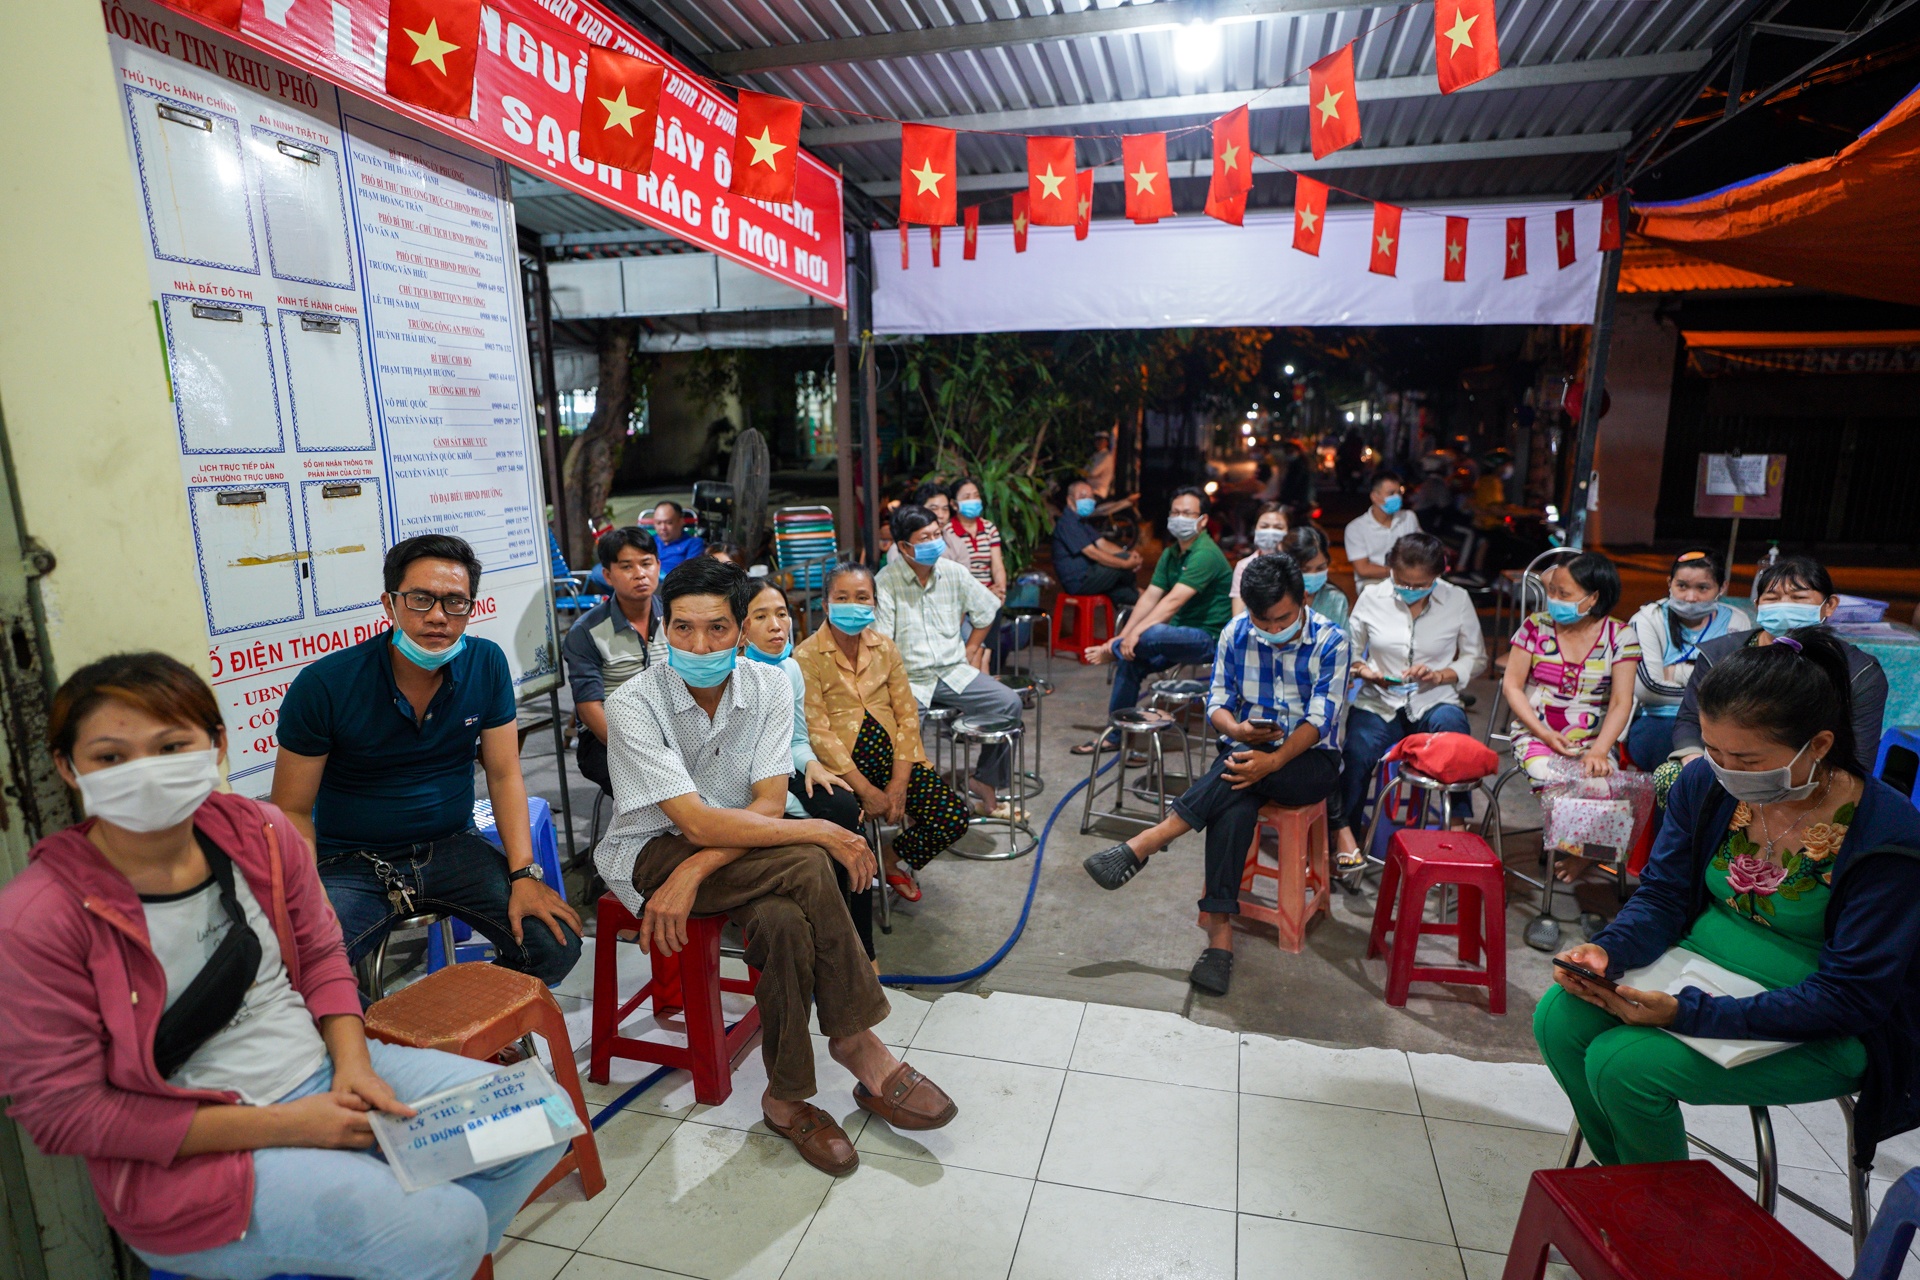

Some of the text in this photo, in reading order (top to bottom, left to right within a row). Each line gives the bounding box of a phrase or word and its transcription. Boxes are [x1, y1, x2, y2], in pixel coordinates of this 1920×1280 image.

[101, 0, 319, 109] ÔNG TIN KHU PHỐ
[258, 114, 272, 127] AN
[273, 118, 294, 132] NINH
[637, 170, 702, 227] RÁC
[711, 196, 730, 241] Ở
[738, 217, 788, 269] MỌI
[793, 246, 829, 287] NƠI
[174, 280, 253, 301] NHÀ ĐẤT ĐÔ THỊ
[277, 295, 297, 306] KINH
[298, 297, 309, 308] TẾ
[310, 300, 333, 311] HÀNH
[199, 464, 218, 473] LỊCH
[242, 461, 258, 470] TIẾP
[260, 461, 275, 469] DÂN
[313, 460, 325, 468] GHI
[343, 458, 363, 467] THÔNG
[191, 474, 208, 483] CỦA
[340, 468, 352, 477] CỦA
[209, 646, 223, 678] Ố
[230, 640, 283, 673] ĐIỆN
[353, 616, 391, 645] ĐƯỜ
[469, 597, 496, 618] NG
[249, 708, 280, 729] CÔ
[254, 734, 279, 753] QU
[493, 1082, 525, 1099] KIỆT
[408, 1136, 427, 1149] ÚI
